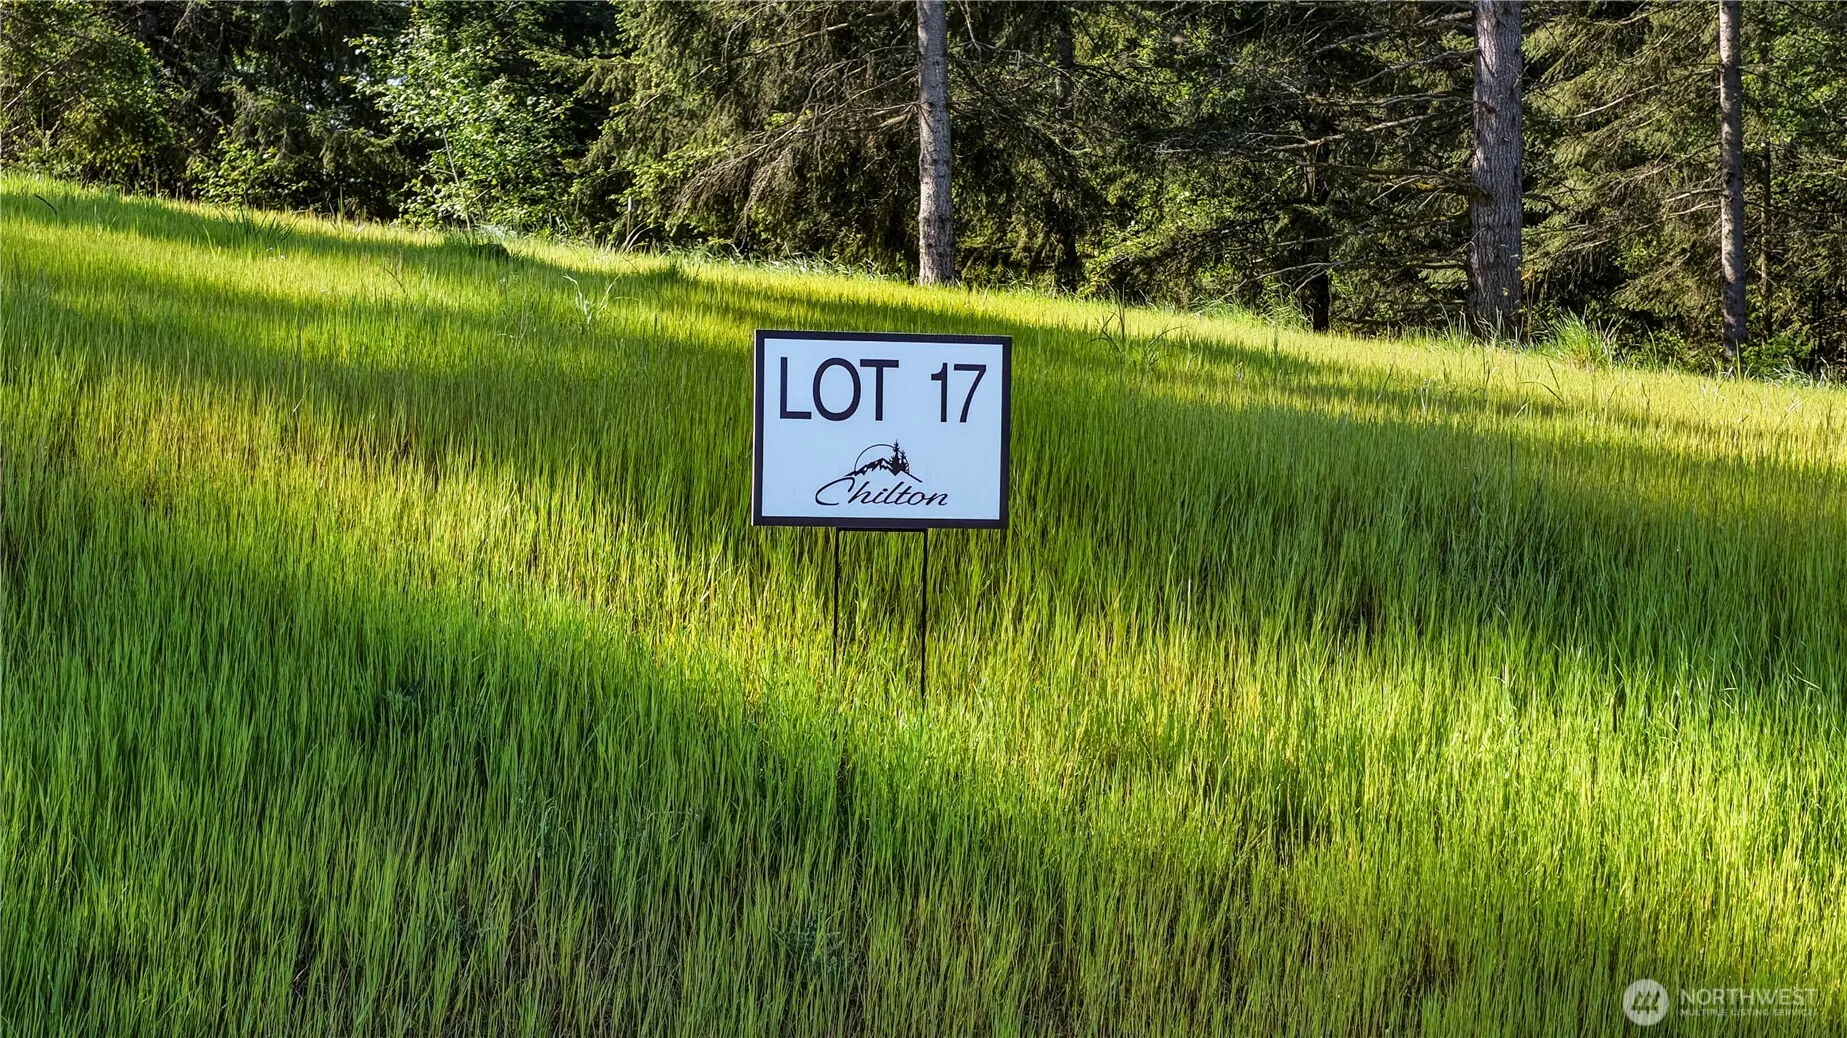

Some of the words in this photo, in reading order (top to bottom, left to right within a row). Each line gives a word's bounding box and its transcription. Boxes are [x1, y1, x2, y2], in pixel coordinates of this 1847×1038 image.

[780, 356, 899, 422] LOT
[930, 362, 987, 423] 17
[815, 476, 948, 506] Chilton
